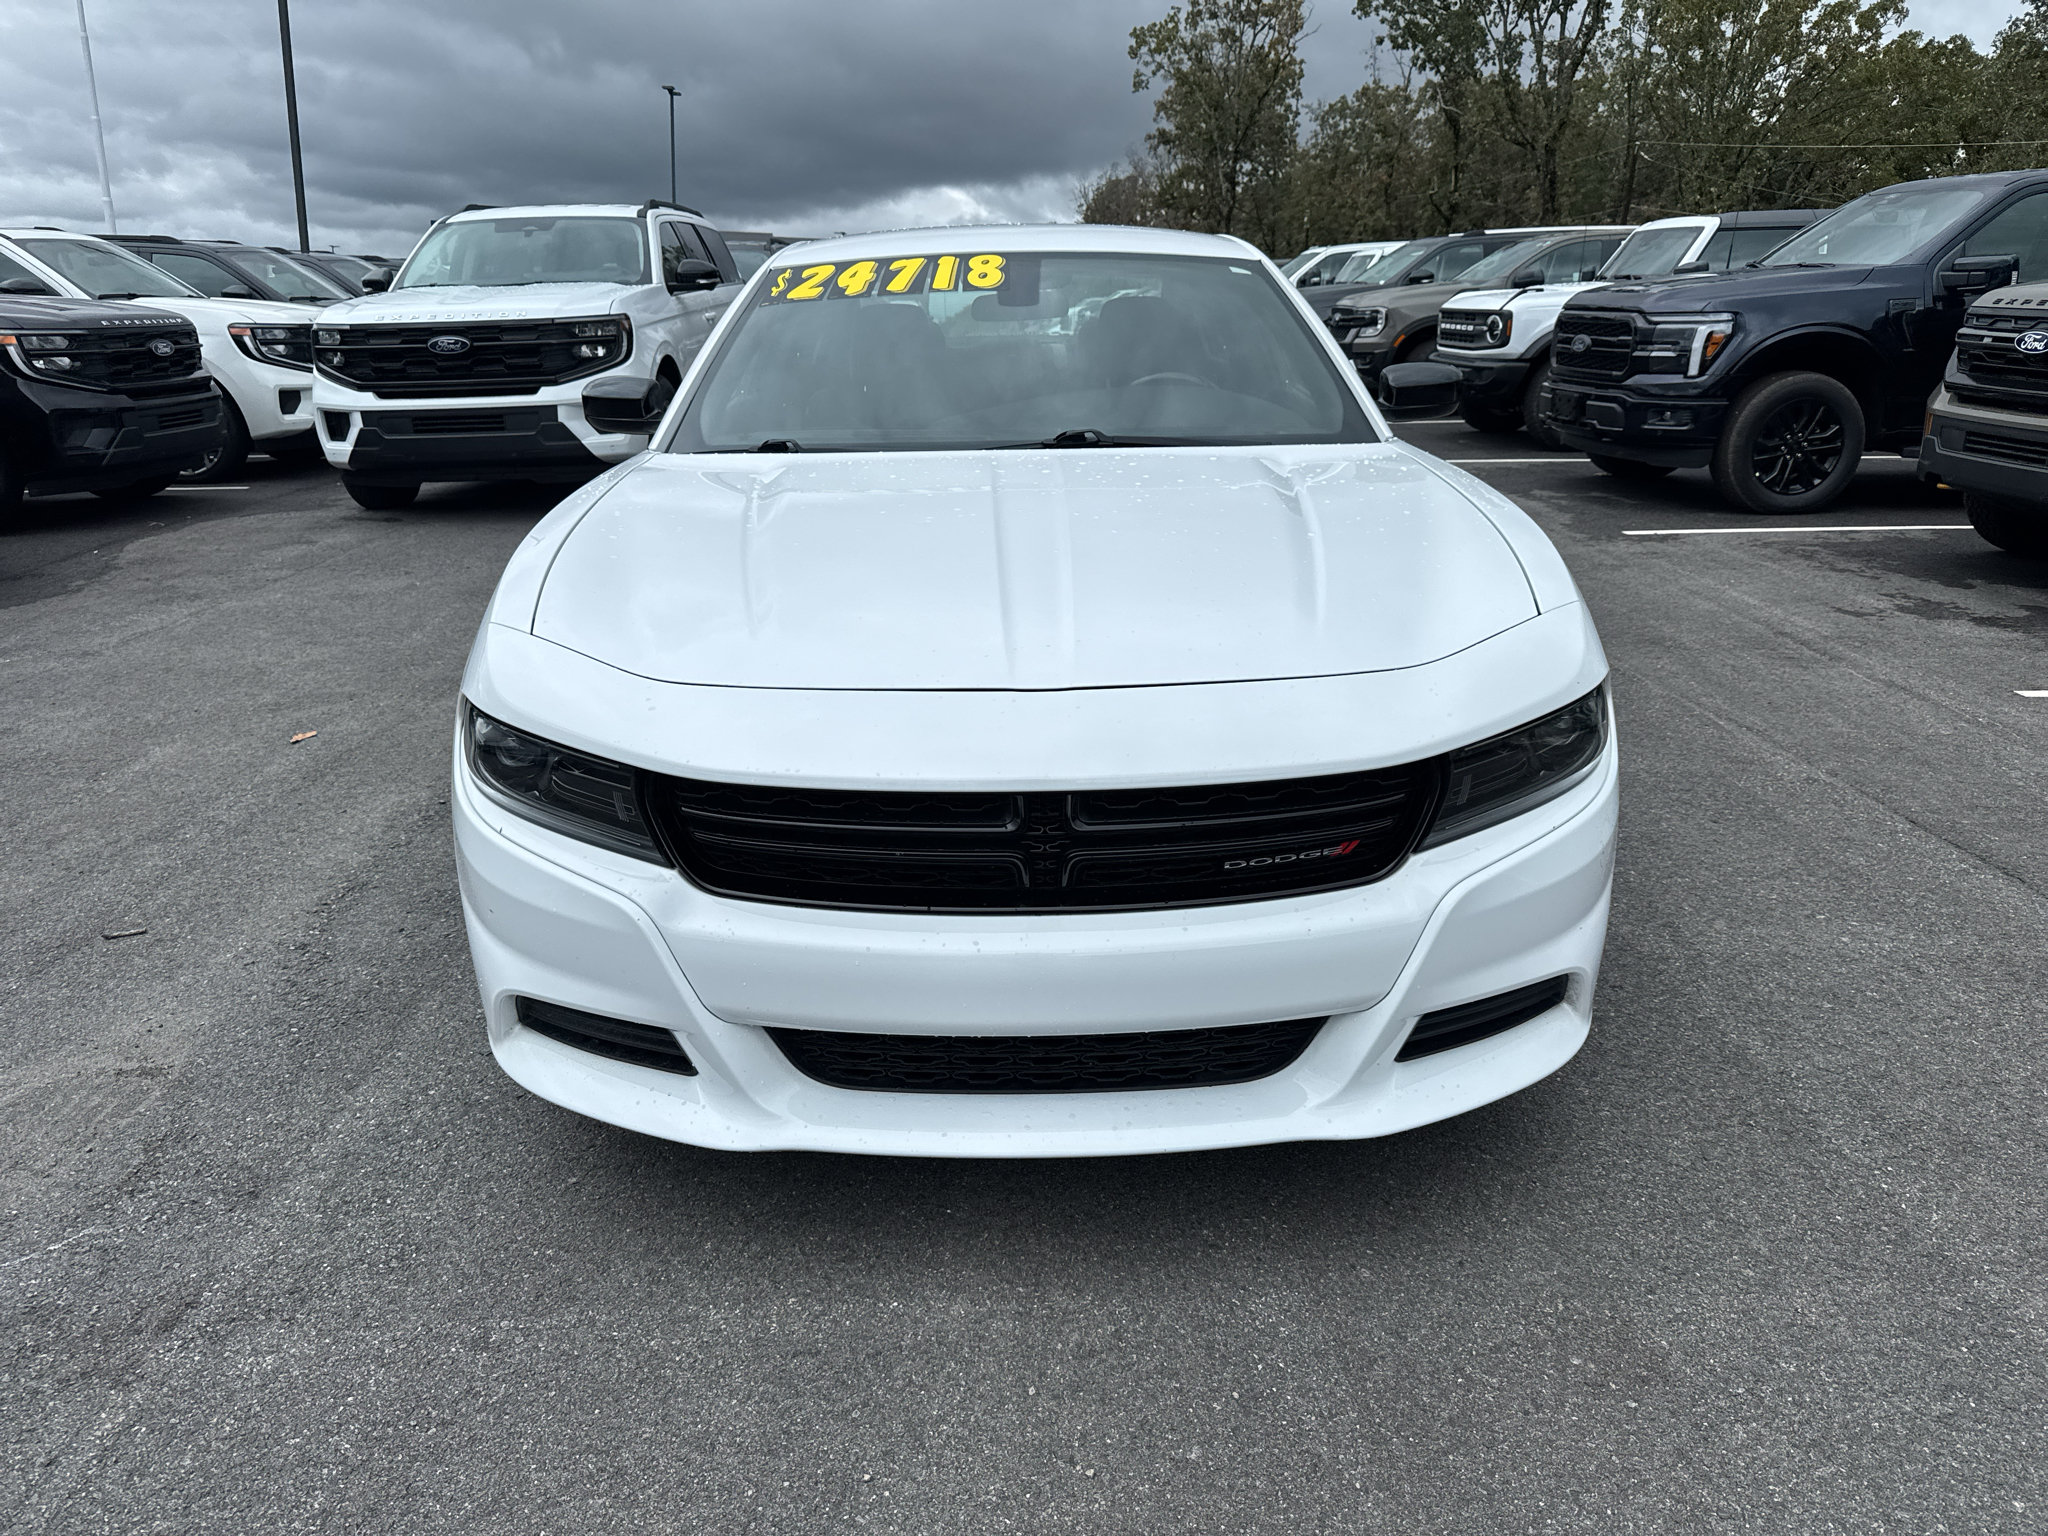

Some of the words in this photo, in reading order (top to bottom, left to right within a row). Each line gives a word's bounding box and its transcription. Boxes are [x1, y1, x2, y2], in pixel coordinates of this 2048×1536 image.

[770, 254, 1006, 300] $24718
[374, 311, 528, 321] EXPEDITION
[2020, 333, 2048, 350] Ford
[1224, 845, 1343, 869] DODGE
